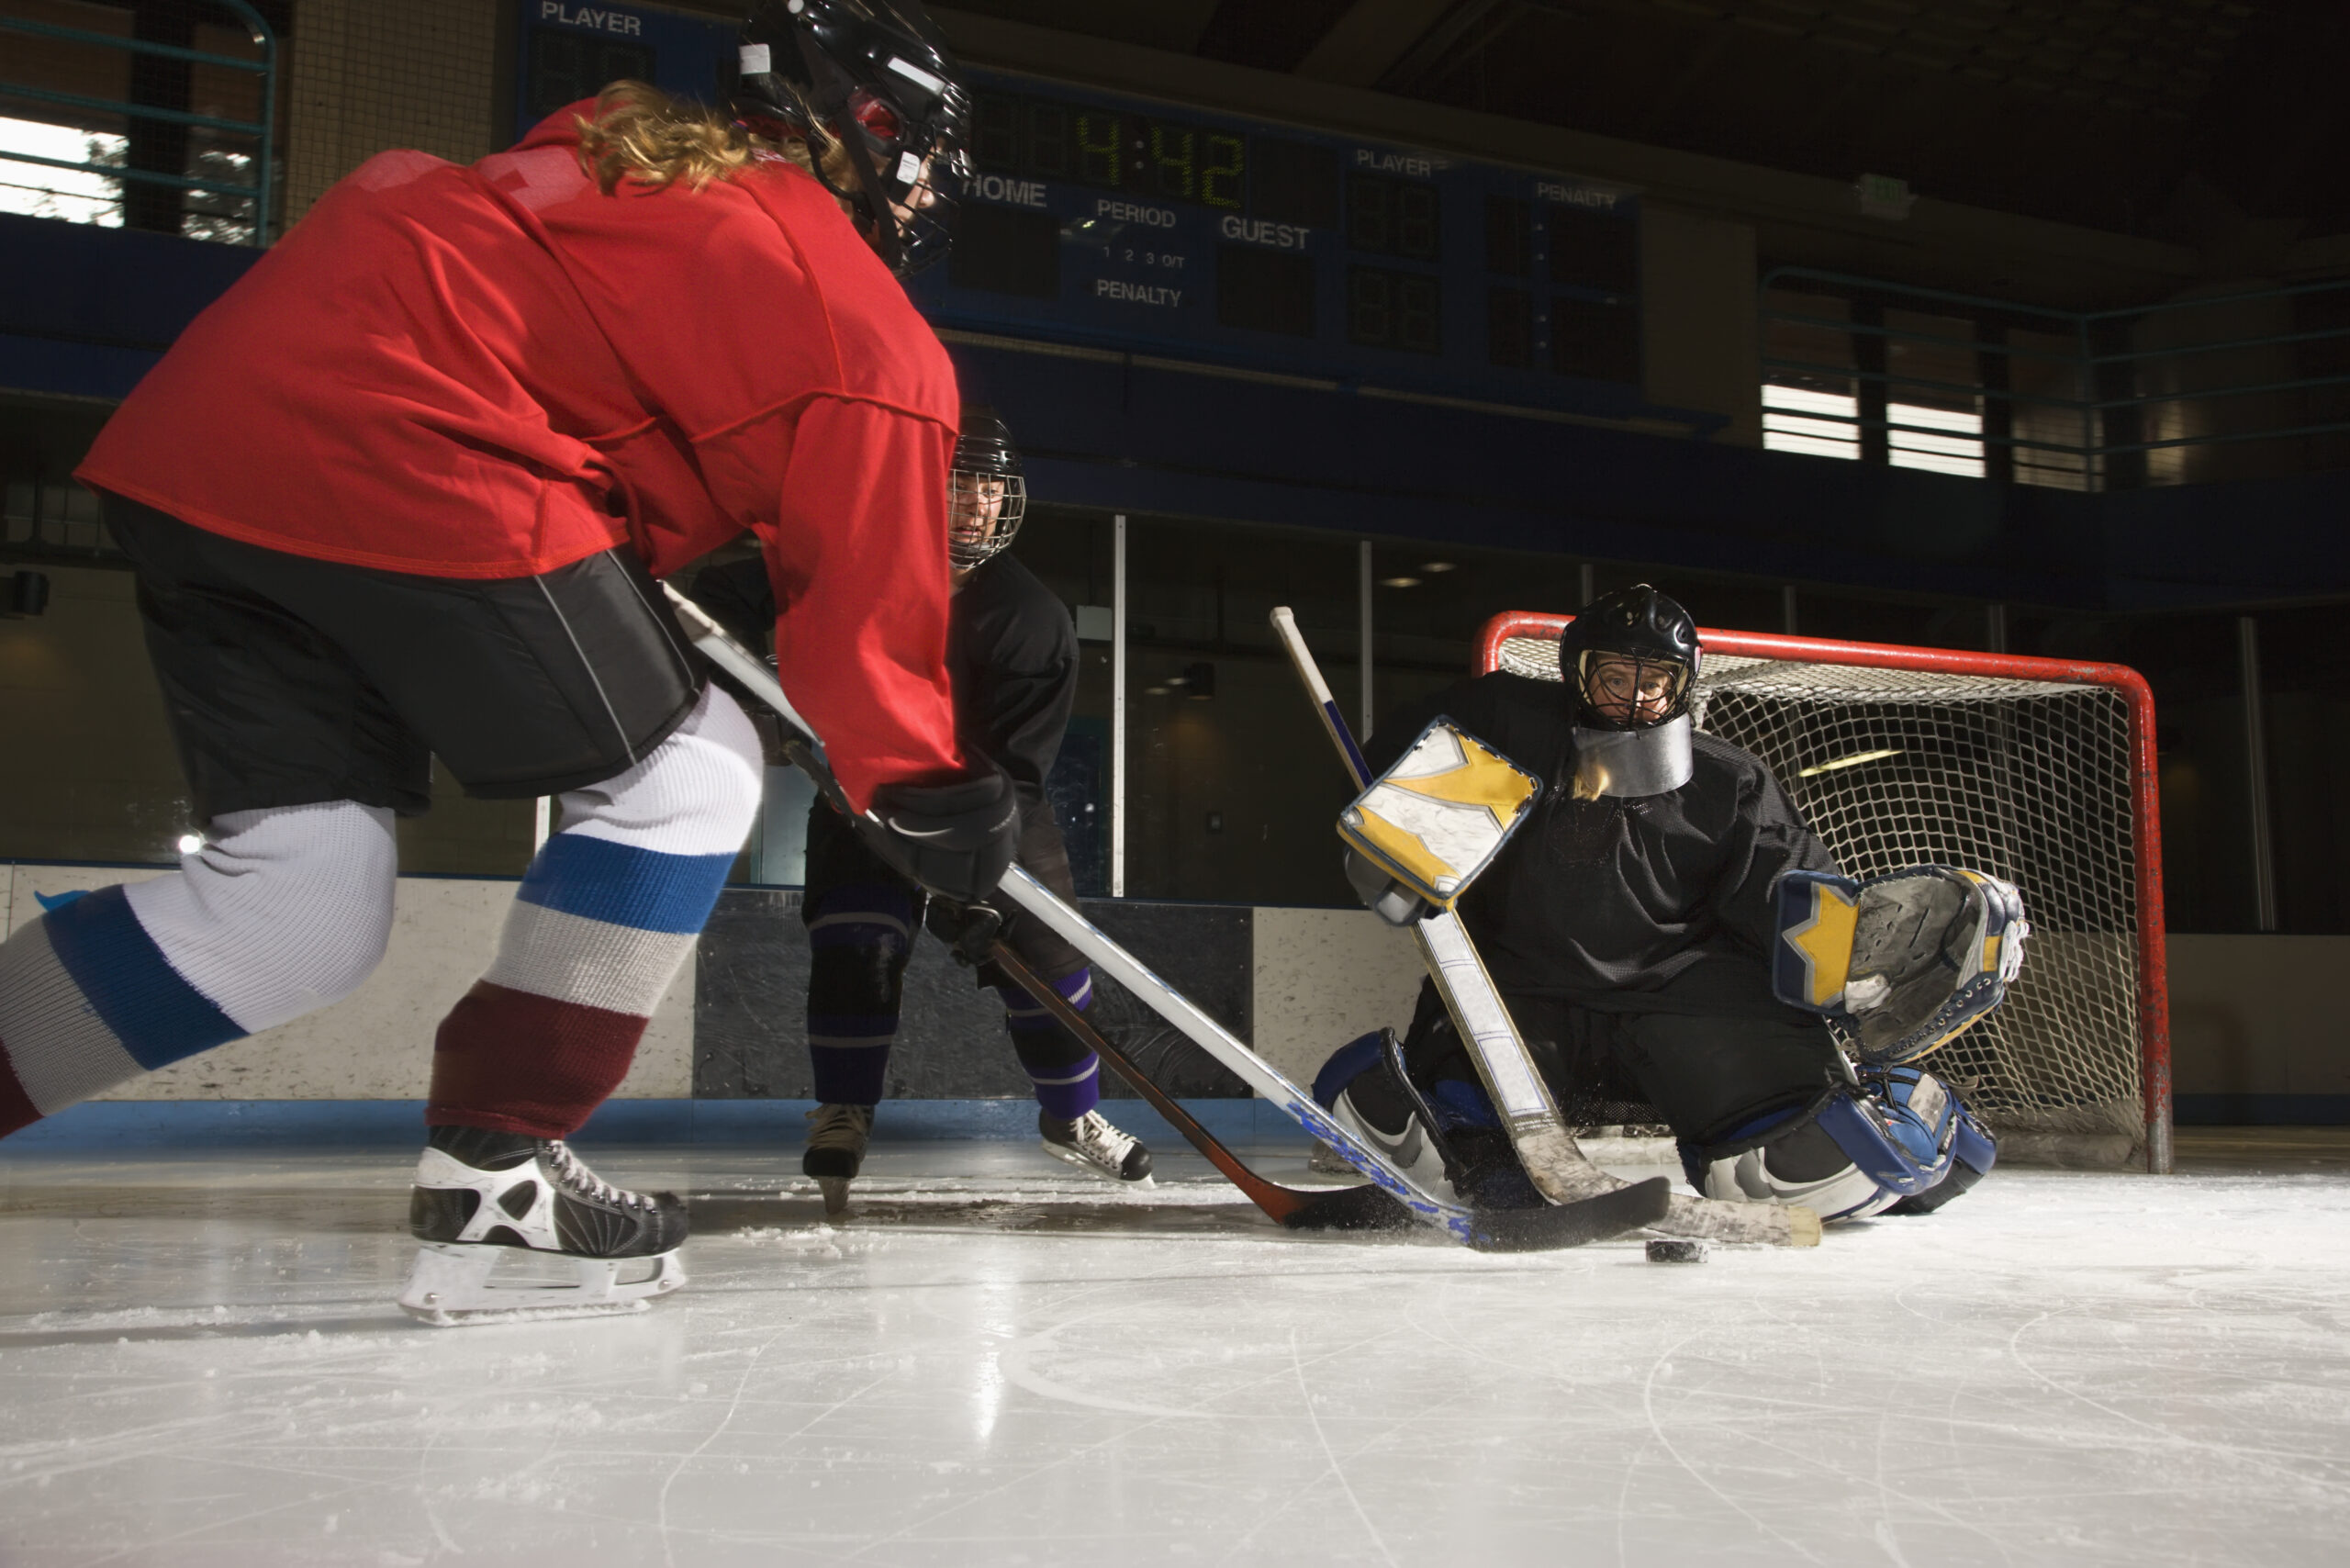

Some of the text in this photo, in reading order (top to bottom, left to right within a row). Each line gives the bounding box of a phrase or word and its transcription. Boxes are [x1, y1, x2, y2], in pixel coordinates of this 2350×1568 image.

[542, 1, 642, 36] PLAYER
[1077, 117, 1244, 209] 4:42
[1356, 149, 1431, 178] PLAYER
[962, 174, 1047, 207] HOME
[1537, 182, 1617, 210] PENALTY
[1097, 198, 1176, 229] PERIOD
[1221, 214, 1310, 250] GUEST
[1103, 246, 1111, 258] 1
[1125, 249, 1135, 263] 2
[1146, 252, 1155, 265] 3
[1097, 279, 1182, 308] PENALTY
